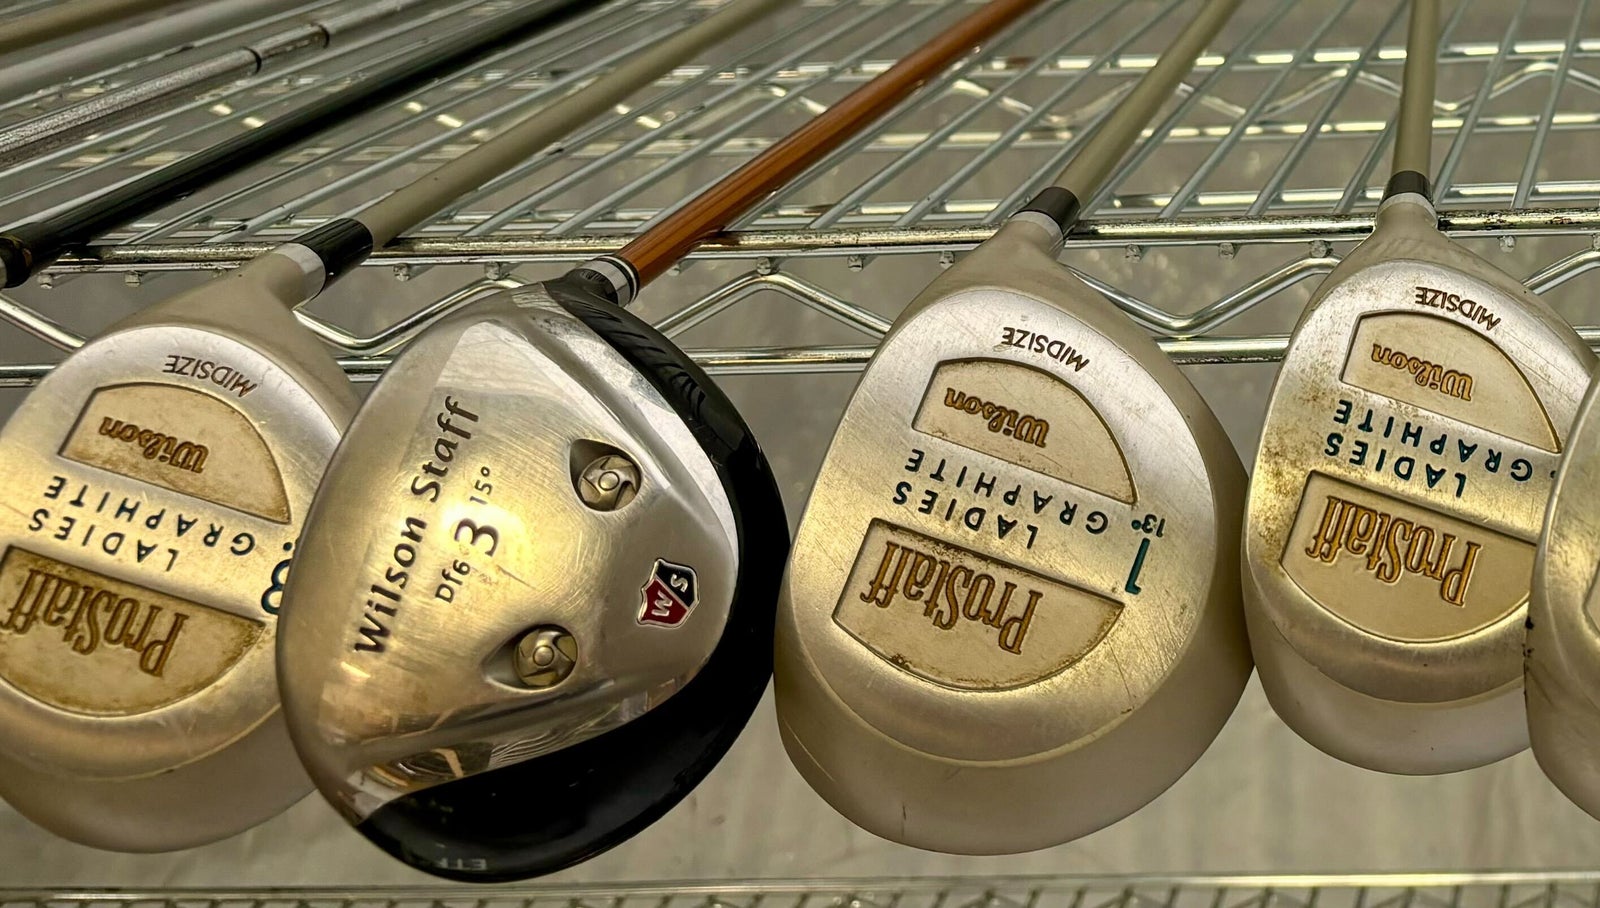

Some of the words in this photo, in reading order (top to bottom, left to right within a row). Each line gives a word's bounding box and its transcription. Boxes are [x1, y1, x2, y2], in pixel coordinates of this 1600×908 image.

[1415, 286, 1501, 331] MIDSIZE
[163, 354, 258, 397] MIDSIZE
[1001, 326, 1090, 372] MIDSIZE
[1371, 343, 1475, 403] Wilson
[99, 416, 209, 474] Wilson
[944, 387, 1050, 448] Wilson
[1334, 399, 1534, 483] GRAPHITE
[905, 449, 1109, 535] GRAPHITE
[1325, 432, 1467, 498] LADIES
[29, 507, 180, 572] LADIES
[44, 475, 256, 556] GRAPHITE
[354, 516, 427, 654] Wilson
[410, 396, 479, 503] Staff
[455, 517, 500, 558] 3
[893, 481, 1039, 549] LADIES
[1124, 538, 1151, 595] 1
